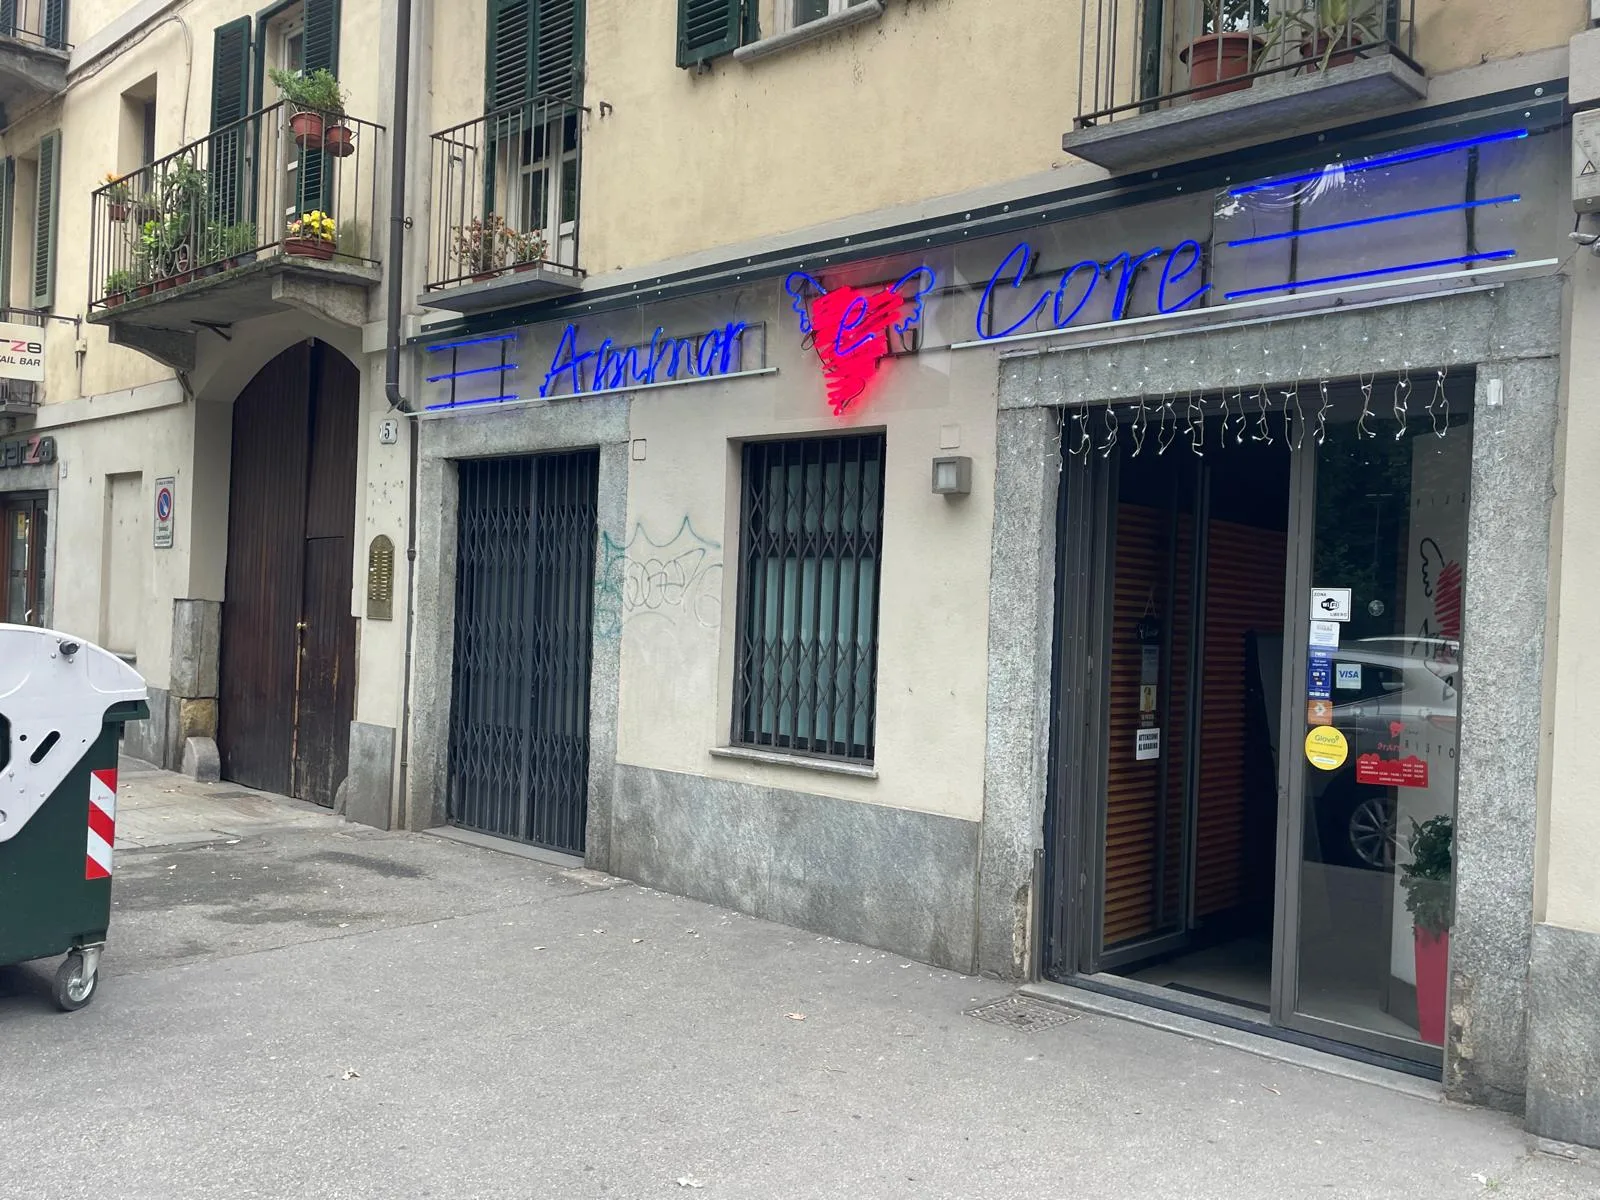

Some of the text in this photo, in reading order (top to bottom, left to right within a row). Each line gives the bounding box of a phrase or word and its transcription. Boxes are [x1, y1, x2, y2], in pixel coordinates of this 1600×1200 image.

[975, 240, 1213, 340] Core
[0, 338, 42, 354] Z8
[0, 355, 41, 367] AIL BAR
[384, 422, 390, 439] 5
[1338, 670, 1359, 678] VISA
[1314, 734, 1340, 744] Glovo
